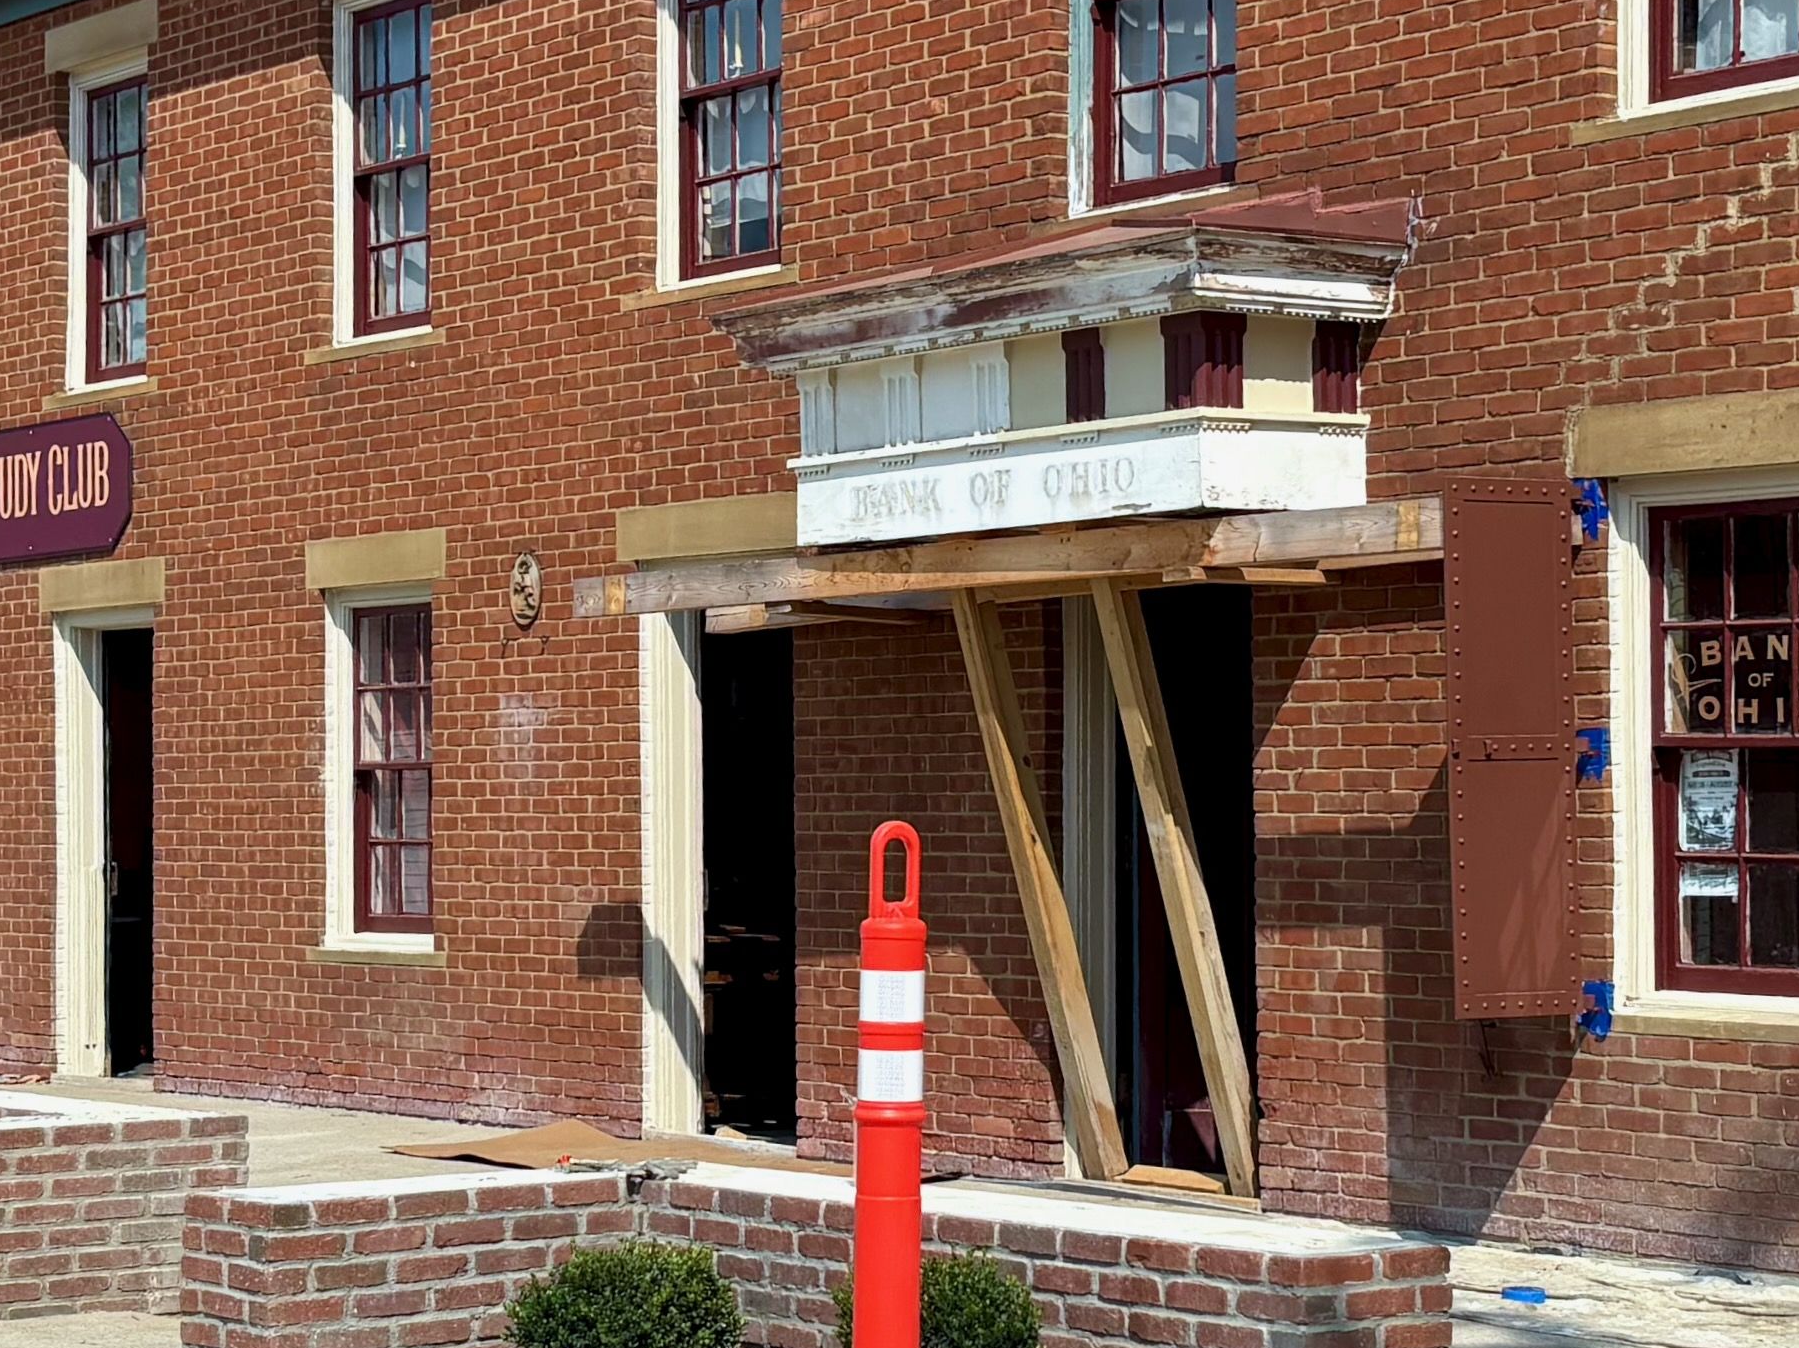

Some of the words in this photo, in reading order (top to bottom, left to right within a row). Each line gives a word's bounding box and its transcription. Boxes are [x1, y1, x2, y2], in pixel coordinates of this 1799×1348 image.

[48, 441, 110, 515] CLUB
[851, 478, 942, 522] BANK
[968, 468, 1011, 508] OF
[1043, 457, 1134, 499] OHIO
[1748, 672, 1775, 688] OF
